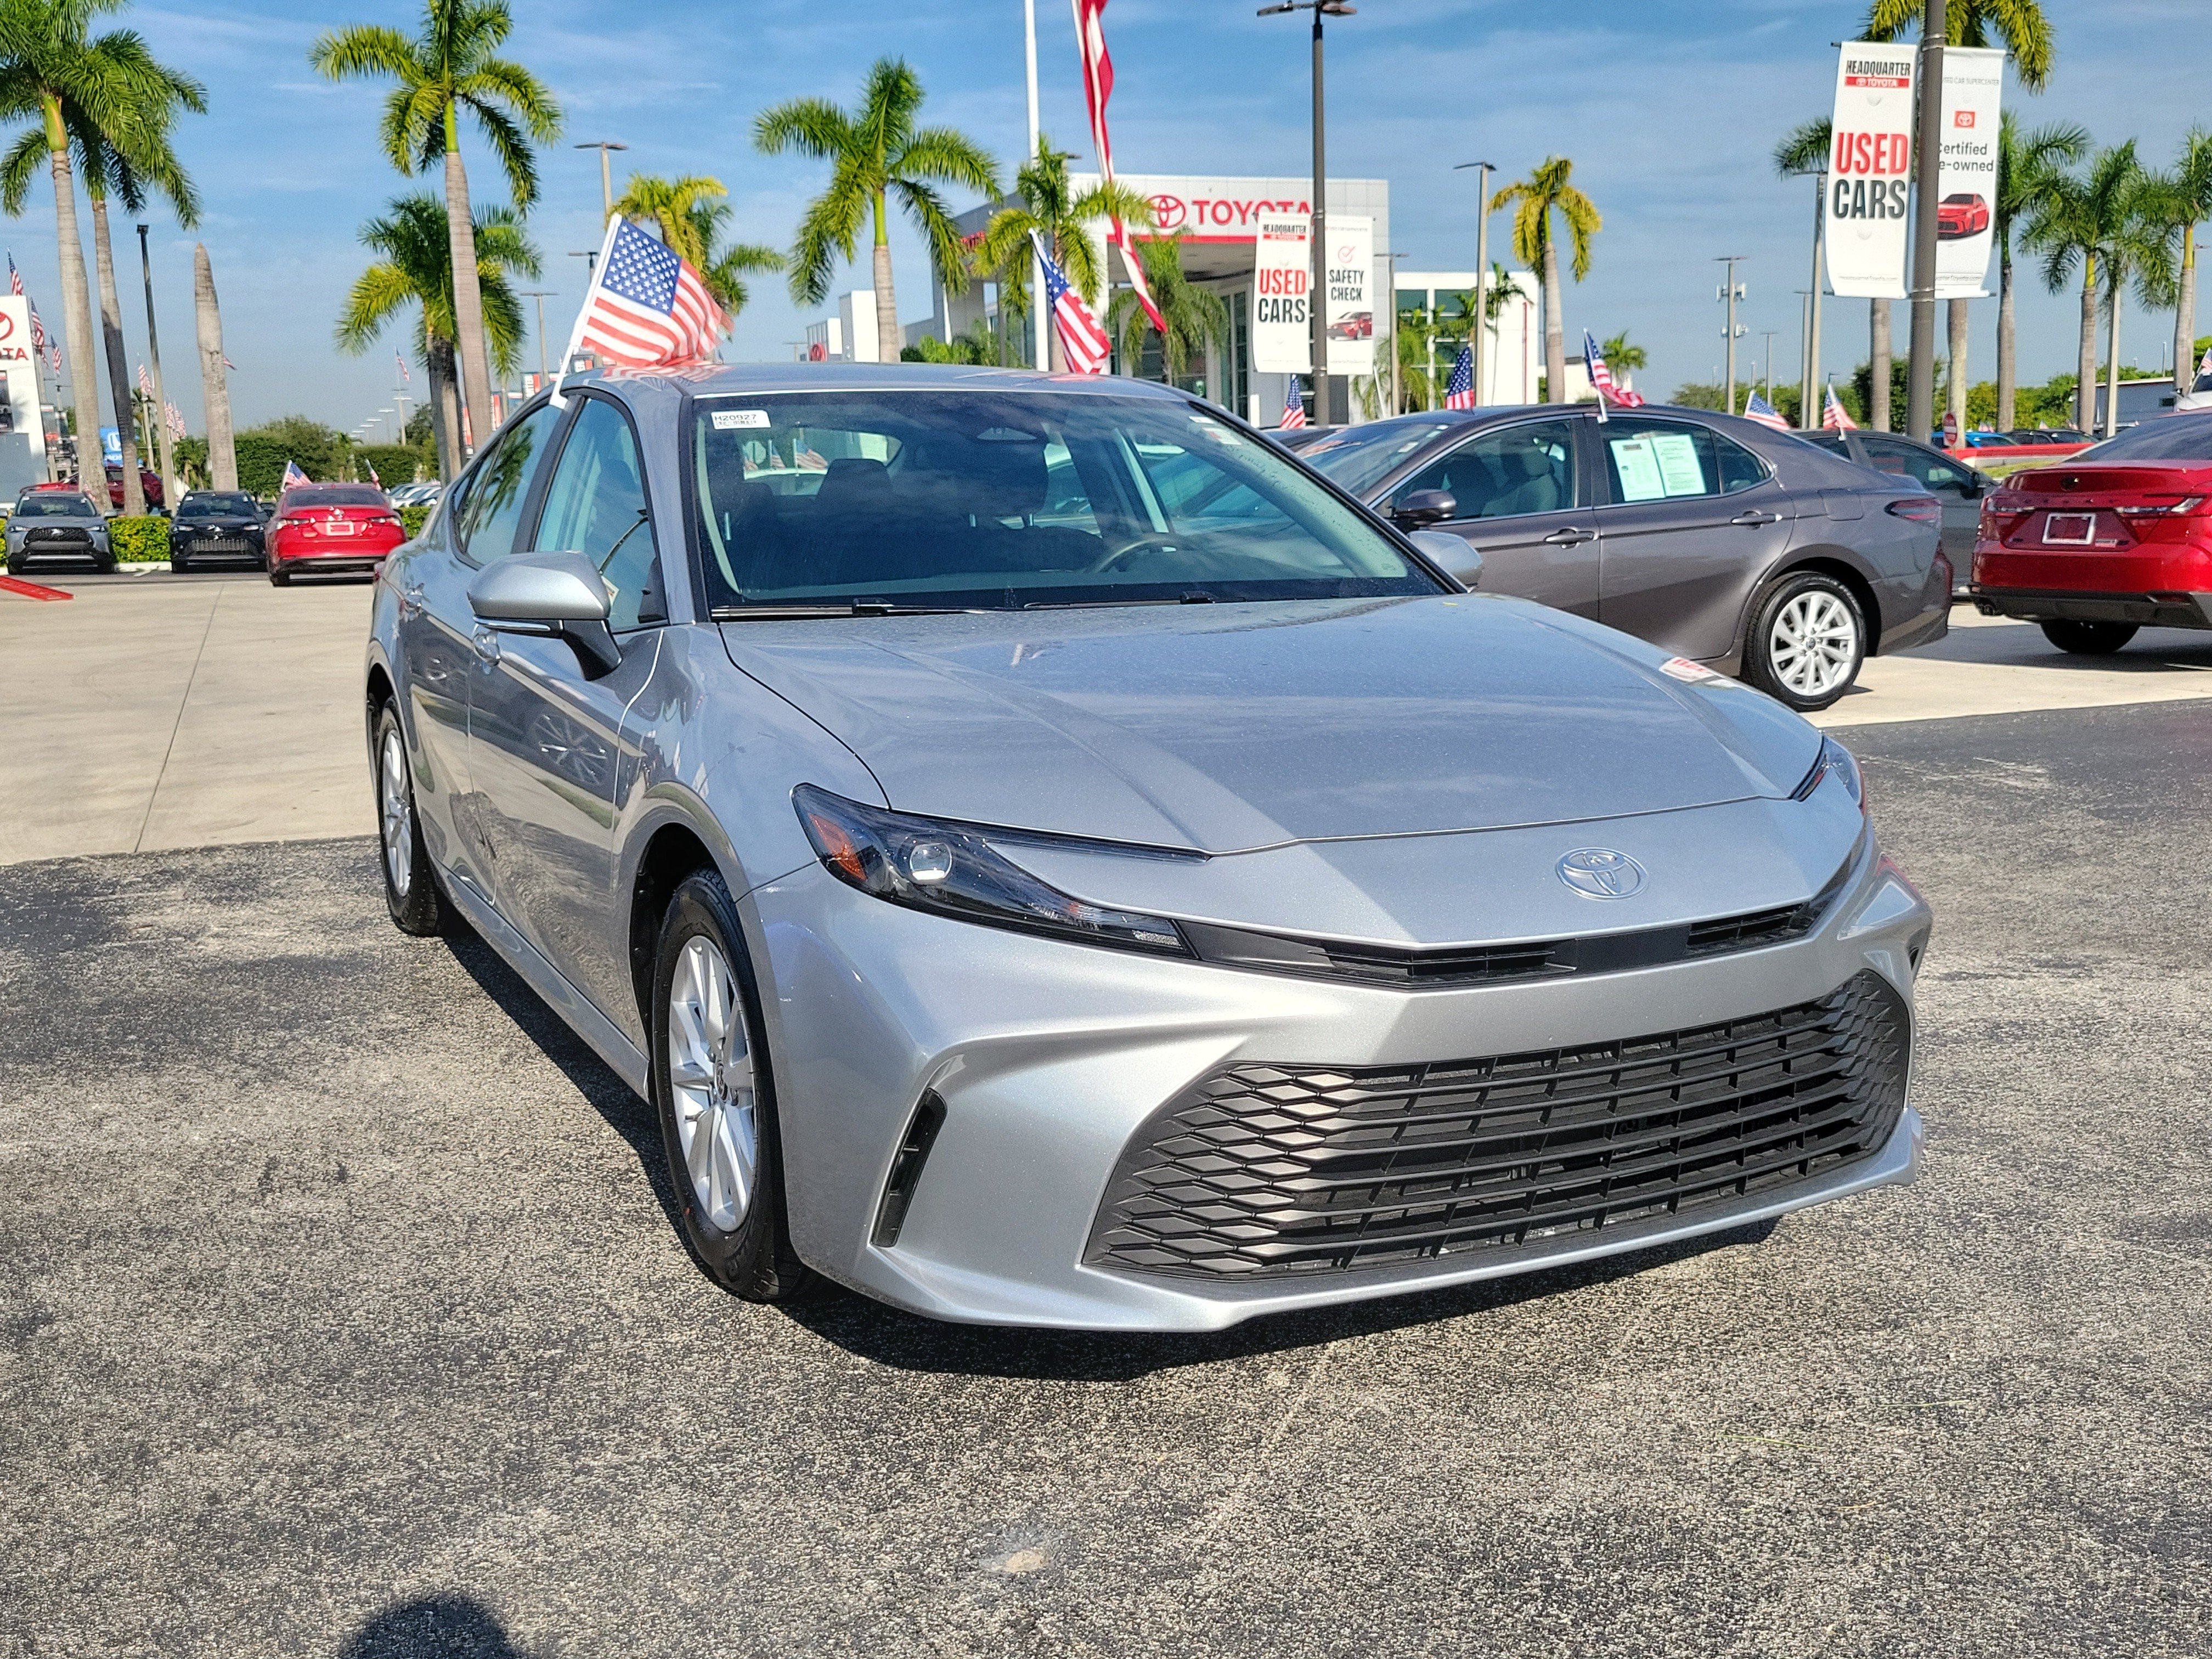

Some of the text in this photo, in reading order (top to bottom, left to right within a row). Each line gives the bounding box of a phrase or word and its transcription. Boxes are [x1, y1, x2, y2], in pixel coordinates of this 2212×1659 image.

[1846, 60, 1910, 76] HEADQUARTER
[1867, 78, 1897, 87] TOYOTA
[1835, 132, 1908, 174] USED
[1939, 160, 1993, 172] e-owned
[1833, 179, 1906, 219] CARS
[1260, 269, 1306, 295] USED
[1329, 269, 1364, 284] SAFETY
[1331, 287, 1362, 301] CHECK
[1259, 298, 1305, 323] CARS
